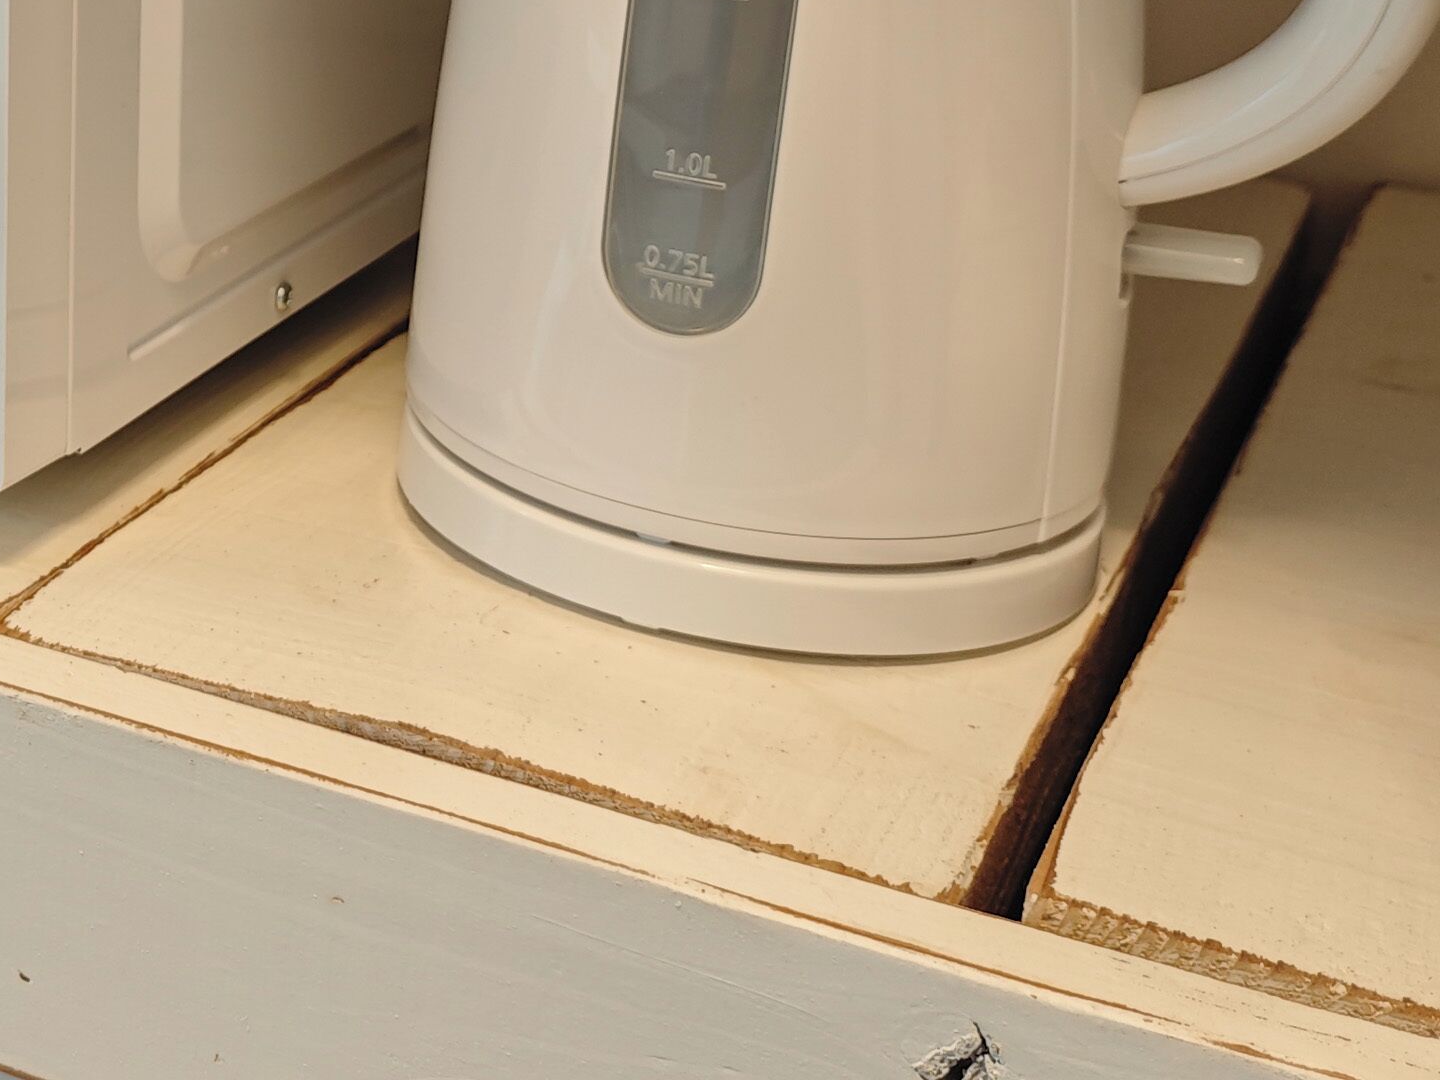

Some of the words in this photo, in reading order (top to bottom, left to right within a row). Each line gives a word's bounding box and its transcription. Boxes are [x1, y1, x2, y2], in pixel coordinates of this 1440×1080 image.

[665, 149, 718, 179] 1.0L
[643, 244, 715, 280] 0.75L
[648, 278, 704, 309] MIN
